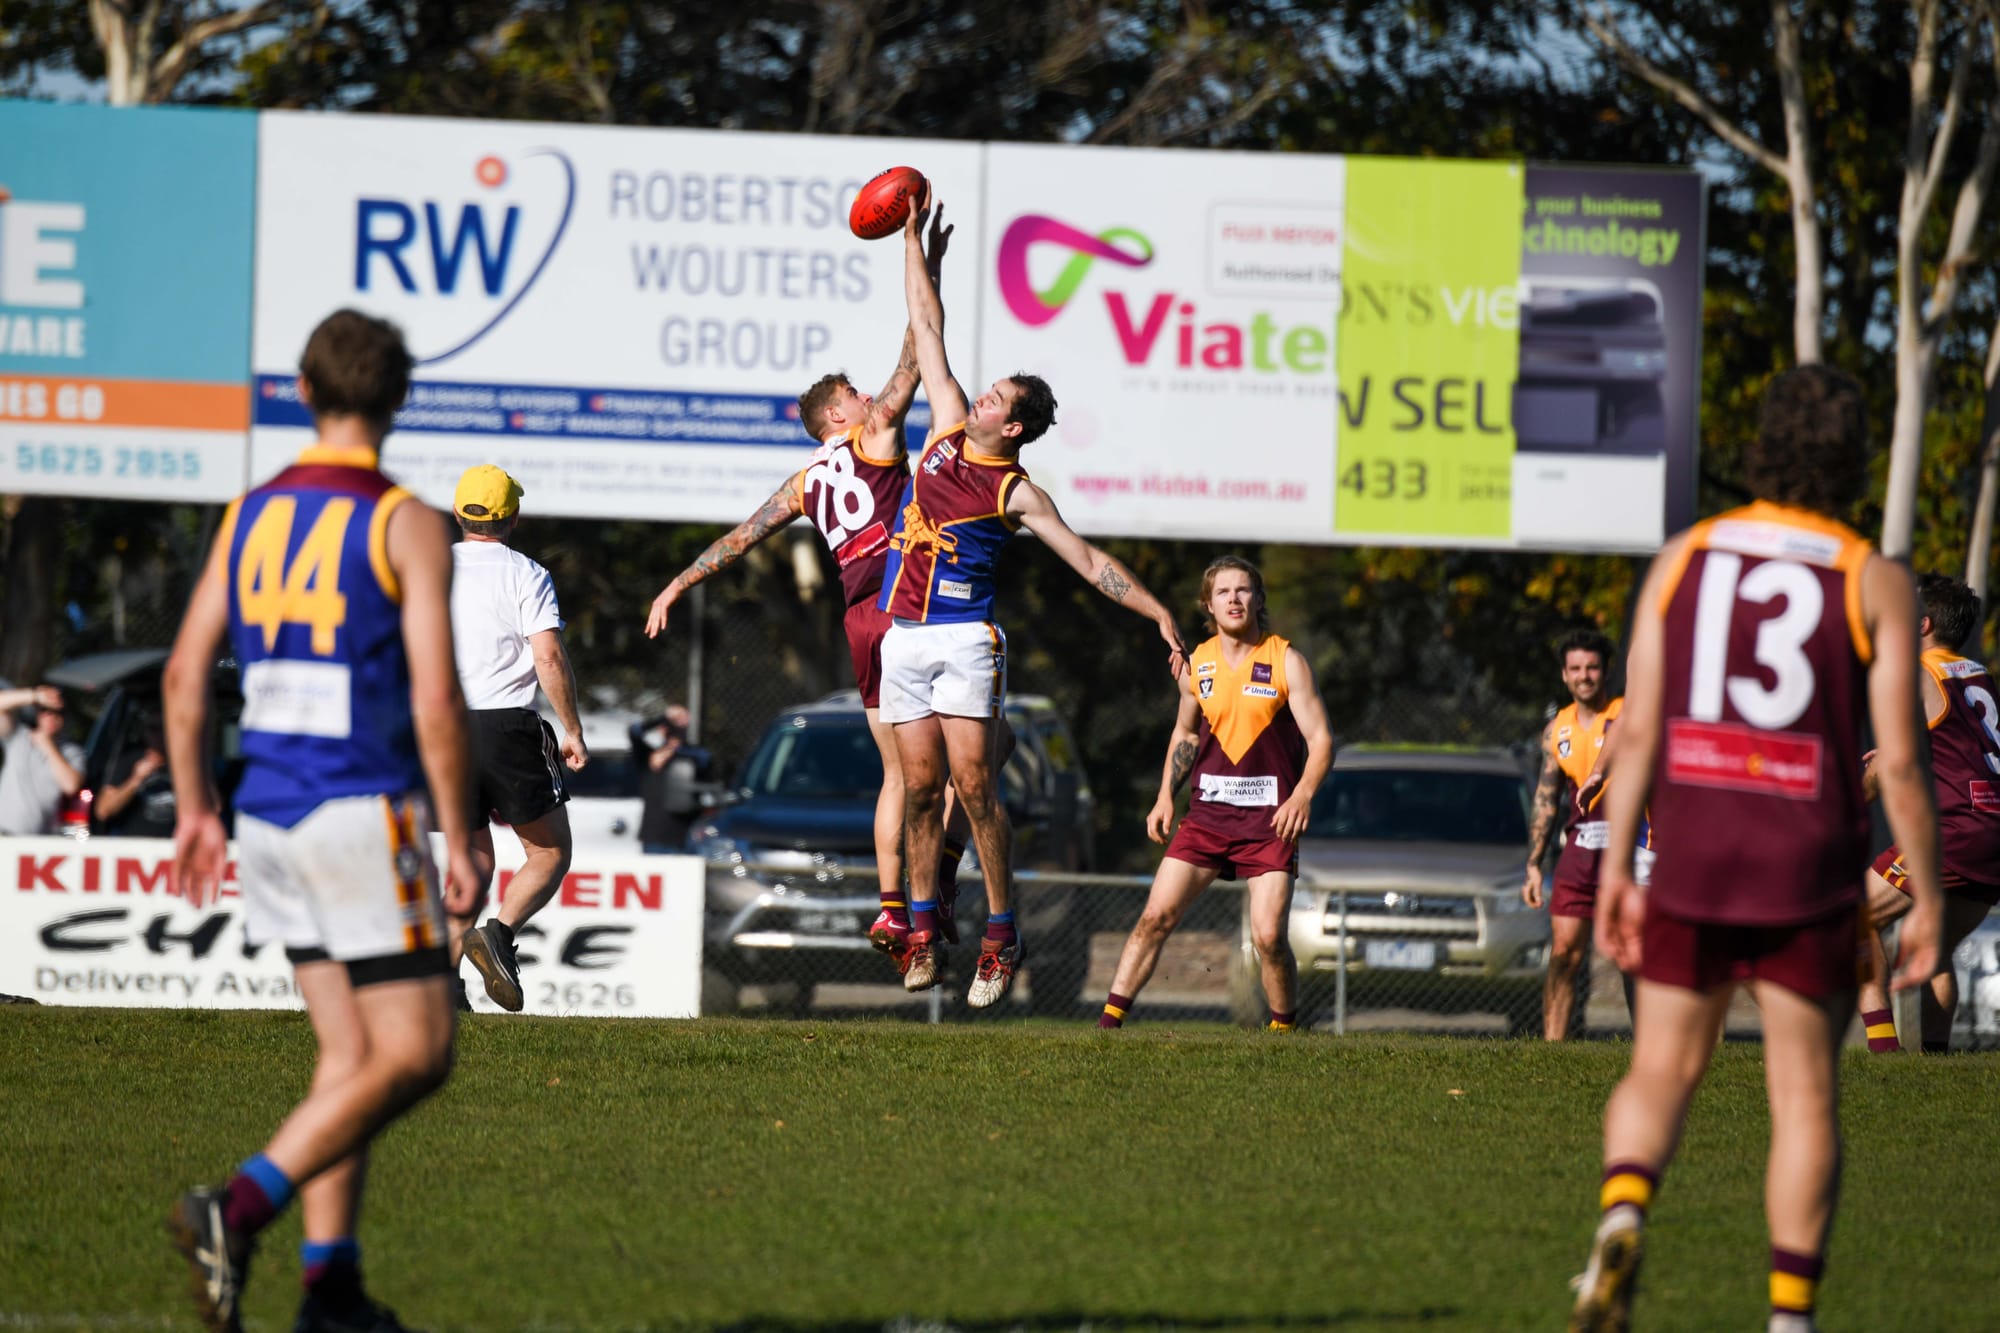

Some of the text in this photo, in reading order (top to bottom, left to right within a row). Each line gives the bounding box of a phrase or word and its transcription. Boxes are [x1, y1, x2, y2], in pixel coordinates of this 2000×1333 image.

[1581, 193, 1664, 220] business
[354, 199, 521, 296] RW
[630, 243, 872, 302] WOUTERS
[658, 315, 833, 371] GROUP
[55, 385, 105, 420] GO
[804, 446, 875, 551] 28
[237, 494, 357, 656] 44
[1688, 551, 1825, 731] 13
[1251, 687, 1277, 697] United
[1224, 780, 1273, 788] WARRAGUL
[1224, 788, 1264, 796] RENAULT
[35, 966, 198, 998] Delivery
[539, 981, 636, 1007] 2626
